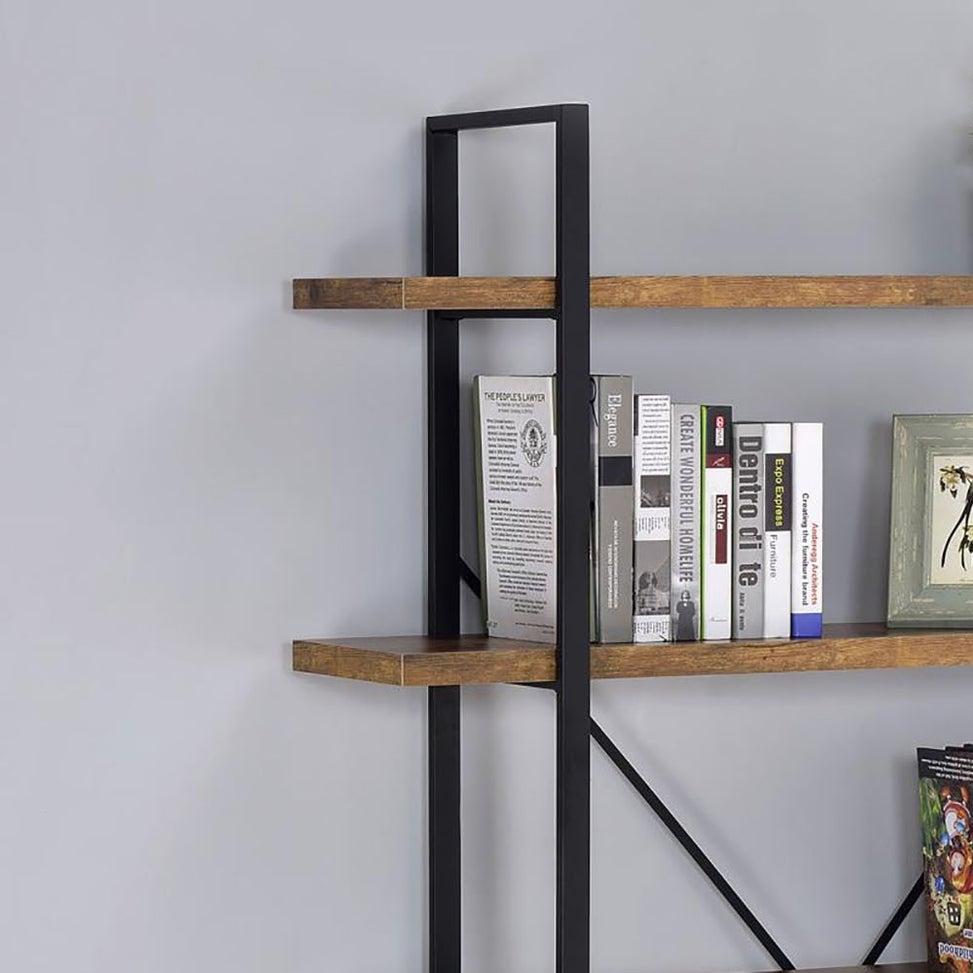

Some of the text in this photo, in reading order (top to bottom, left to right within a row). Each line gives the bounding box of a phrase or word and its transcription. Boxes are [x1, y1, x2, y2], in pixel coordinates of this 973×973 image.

[484, 391, 495, 401] THE
[523, 393, 545, 402] LAWYER
[604, 394, 622, 447] Elegance
[680, 414, 694, 582] CREATE WONDERFUL HOMELIFE
[716, 497, 726, 530] olivia
[739, 436, 762, 586] Dentro di te
[774, 458, 784, 527] Expo Express
[801, 493, 809, 528] Creating
[769, 534, 778, 578] Furniture
[810, 523, 819, 605] Anderegg Architects
